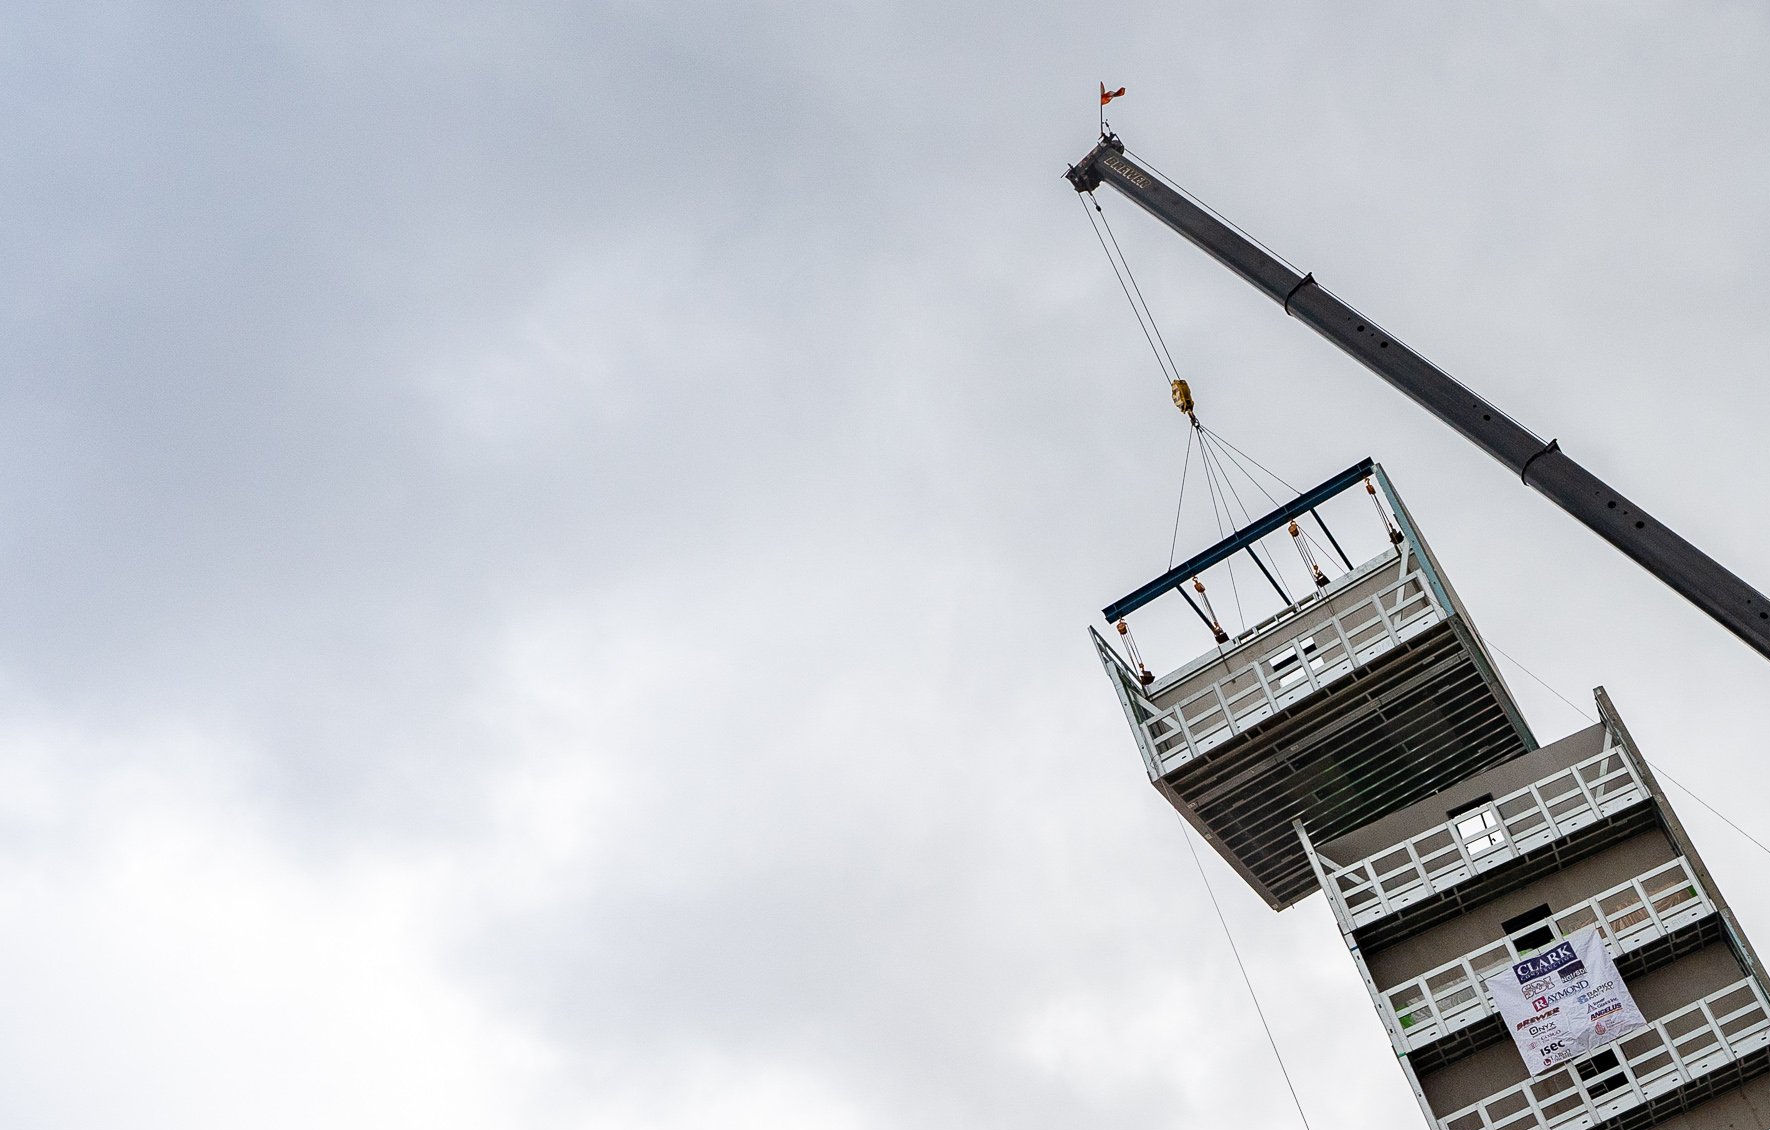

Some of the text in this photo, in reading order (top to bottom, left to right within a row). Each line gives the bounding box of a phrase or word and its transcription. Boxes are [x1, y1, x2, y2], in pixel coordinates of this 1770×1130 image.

[1103, 155, 1152, 189] BREWER
[1517, 944, 1571, 976] CLARK
[1520, 953, 1574, 981] CONSTRUCTION
[1533, 980, 1589, 1012] RAYMOND
[1516, 1006, 1560, 1031] BREWER
[1590, 1002, 1622, 1021] ANGELUS
